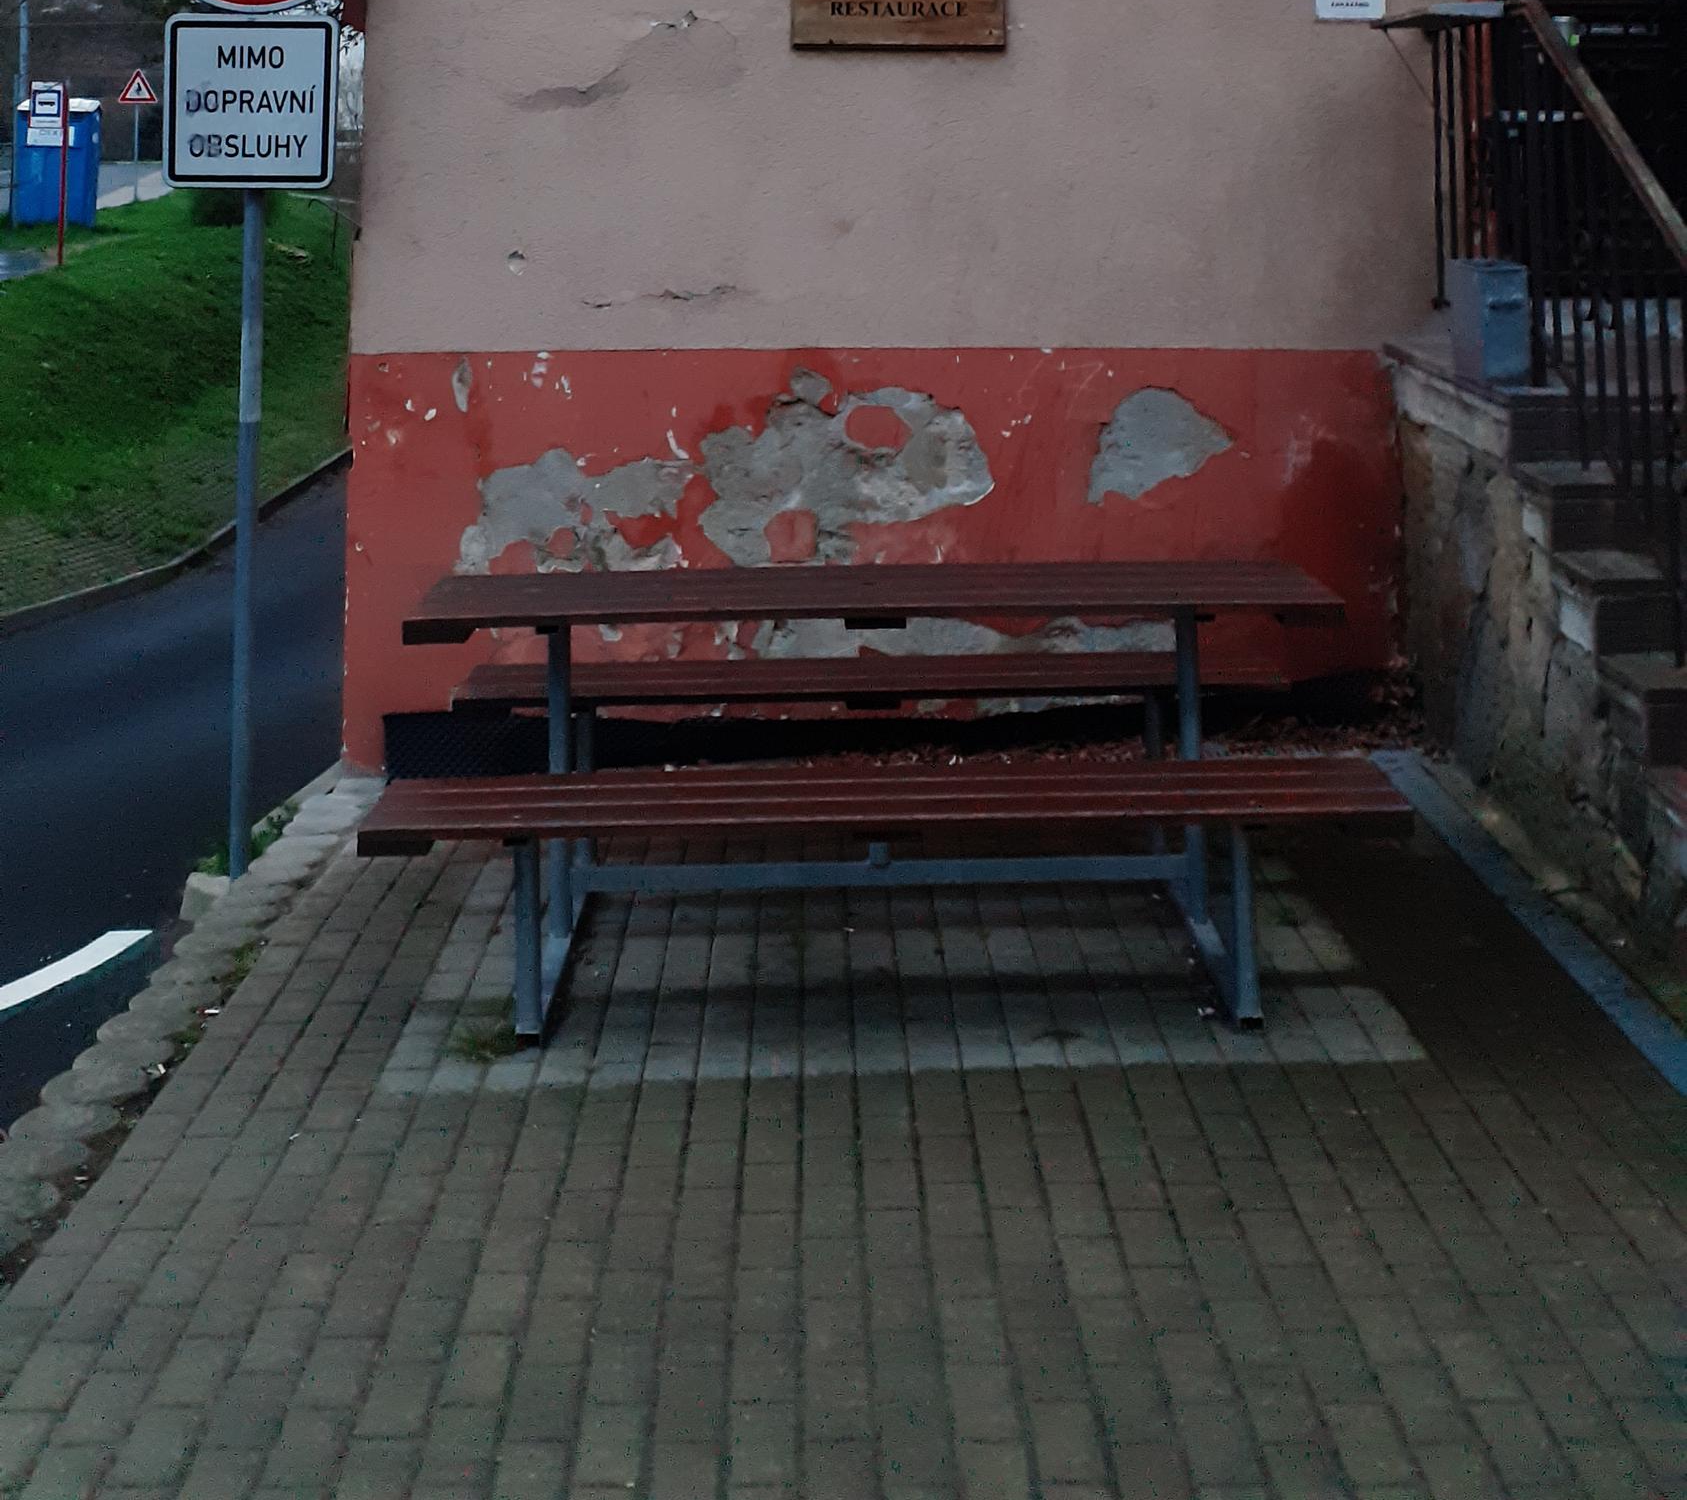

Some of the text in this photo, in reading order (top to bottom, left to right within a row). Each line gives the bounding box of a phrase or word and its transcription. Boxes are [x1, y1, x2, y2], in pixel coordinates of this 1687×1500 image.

[830, 1, 968, 17] RESTAURACE
[217, 45, 285, 69] MIMO
[185, 85, 317, 114] DOPRAVNÍ
[188, 134, 308, 159] OBSLUHY
